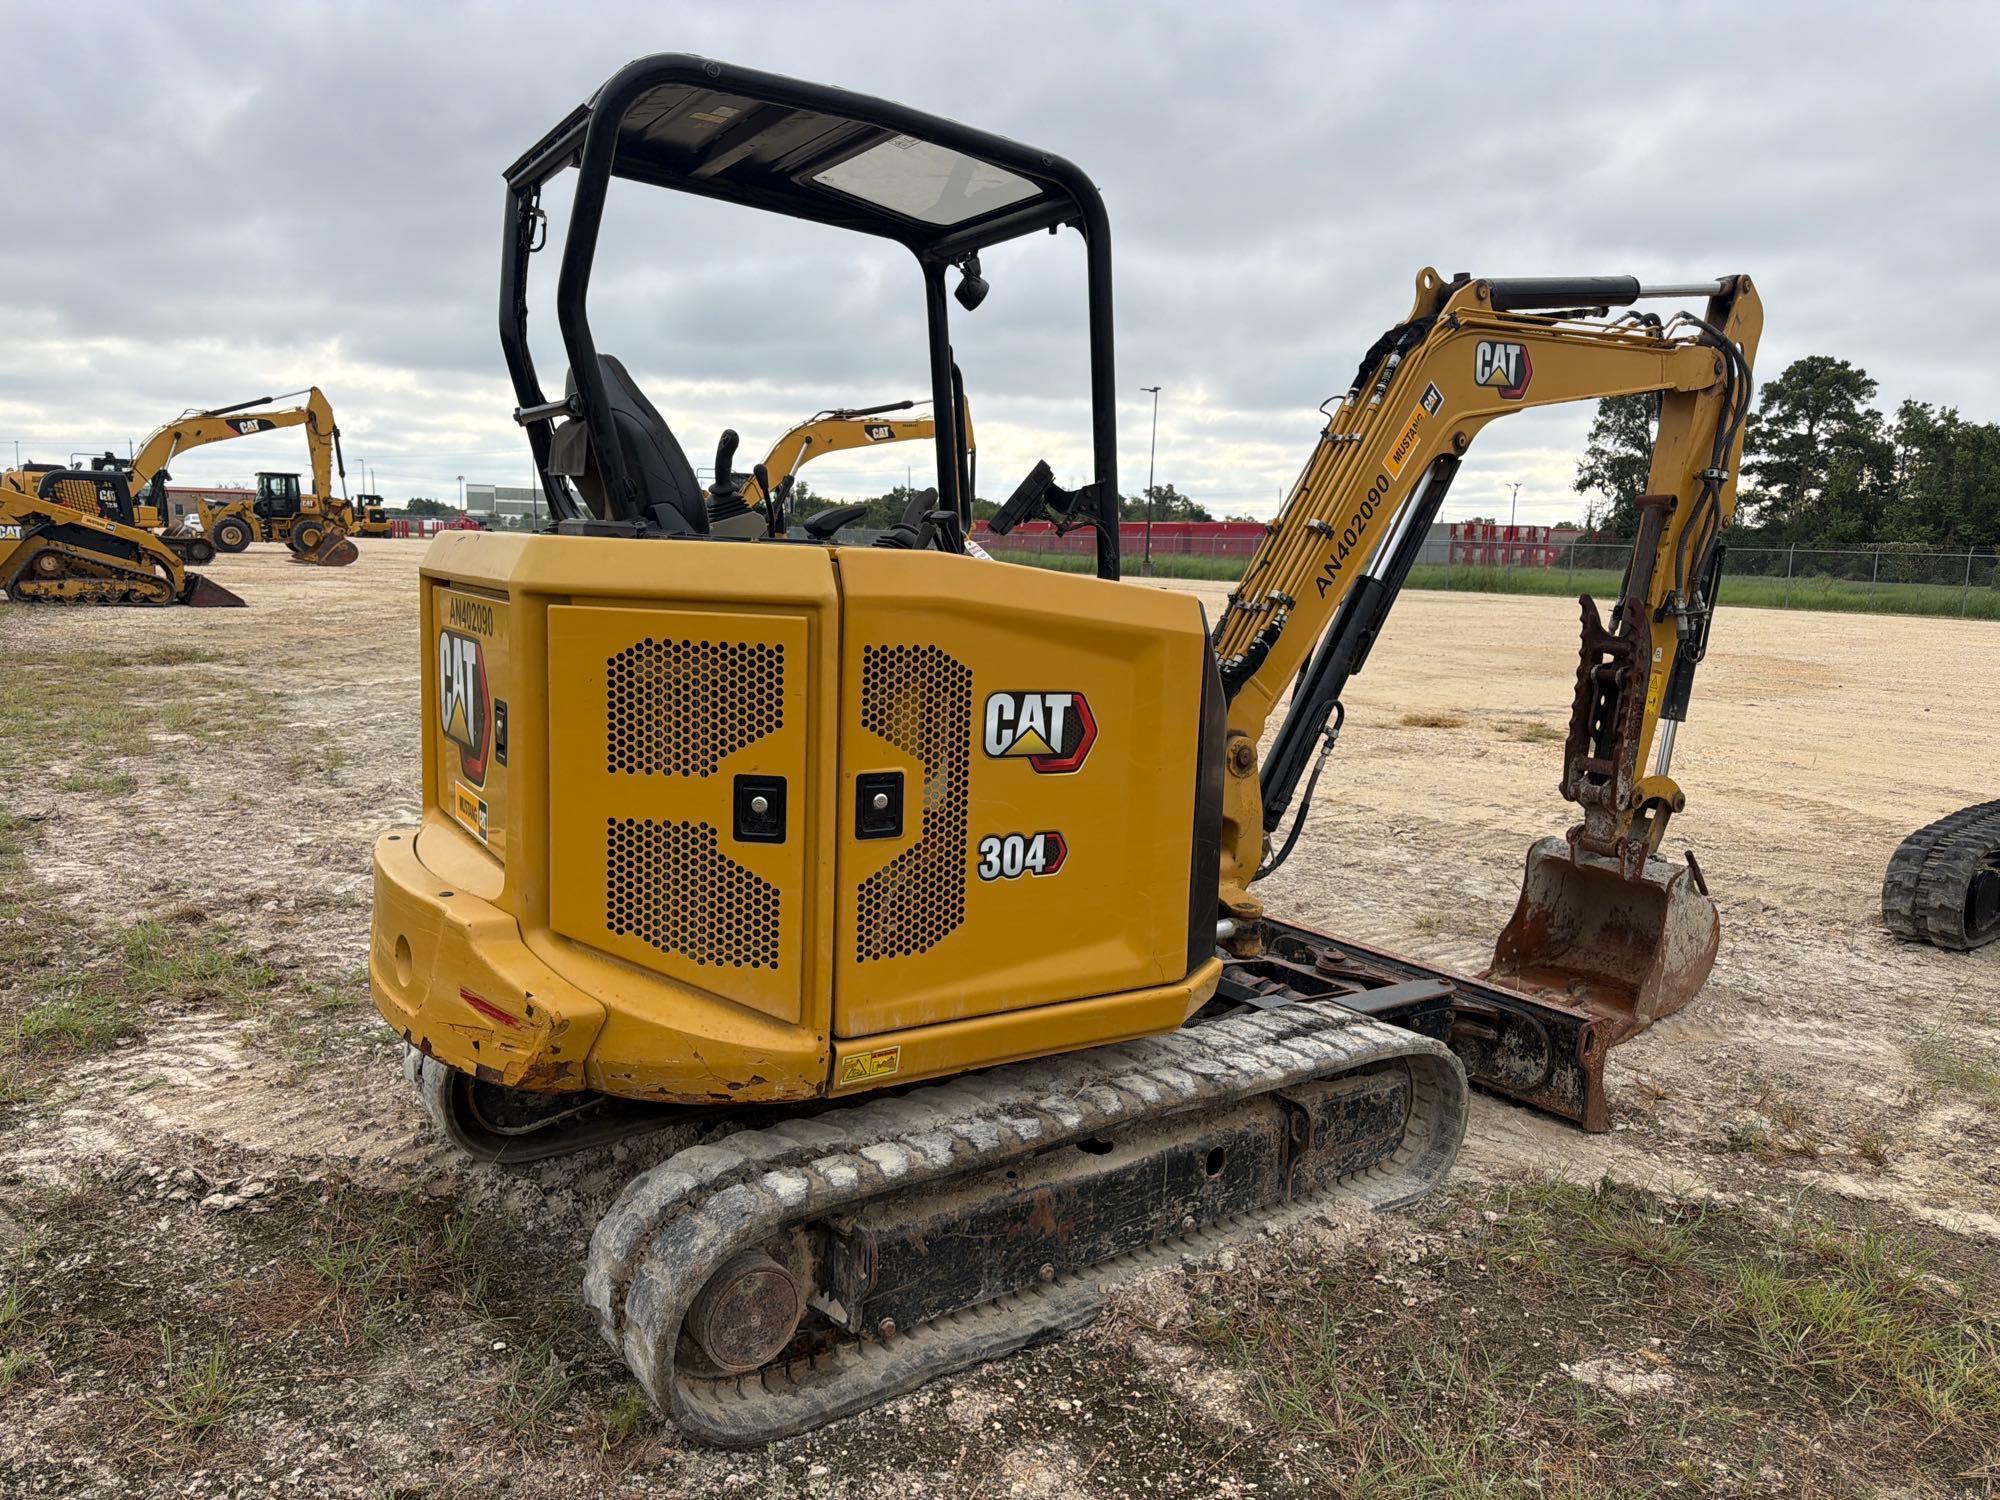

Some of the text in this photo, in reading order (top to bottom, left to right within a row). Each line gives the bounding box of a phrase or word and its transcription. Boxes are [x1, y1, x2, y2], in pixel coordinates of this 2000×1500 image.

[1476, 341, 1522, 386] CAT
[1423, 388, 1439, 412] CAT
[239, 419, 260, 434] CAT
[872, 427, 890, 439] CAT
[302, 500, 314, 508] CAT
[0, 525, 22, 540] CAT
[1314, 473, 1389, 600] AN402090
[449, 597, 494, 638] AN402090
[439, 630, 477, 749] CAT
[985, 692, 1072, 756] CAT
[979, 834, 1046, 879] 304
